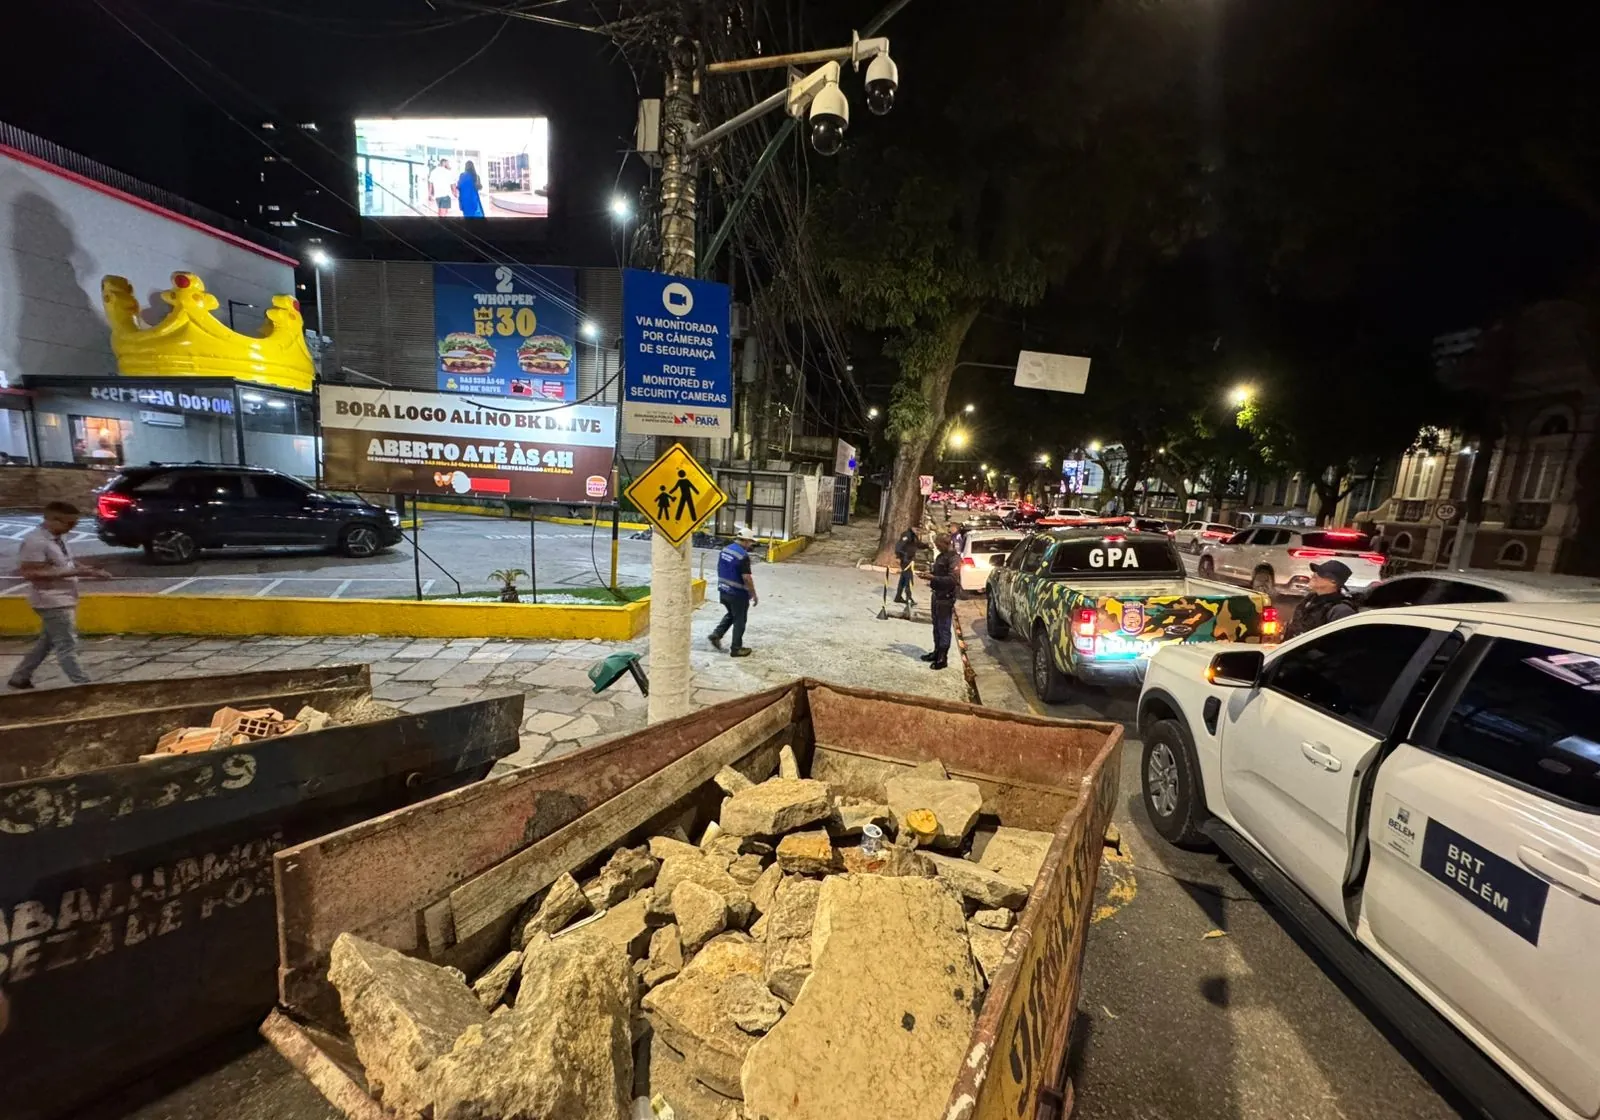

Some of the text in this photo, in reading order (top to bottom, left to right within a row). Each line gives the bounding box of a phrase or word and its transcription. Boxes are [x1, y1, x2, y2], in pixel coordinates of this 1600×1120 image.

[495, 266, 514, 293] 2
[473, 293, 534, 306] WHOPPER
[474, 307, 537, 337] R$ 30
[635, 315, 719, 335] VIA MONITORADA
[642, 330, 713, 347] POR CÂMERAS
[640, 343, 716, 361] DE SEGURANÇA
[663, 364, 697, 377] ROUTE
[642, 374, 715, 390] MONITORED BY
[631, 386, 727, 403] SECURITY CAMERAS
[335, 400, 391, 418] BORA
[394, 405, 447, 422] LOGO
[485, 411, 511, 427] NO
[514, 413, 541, 429] BK
[367, 438, 574, 469] ABERTO ATÉ ÀS 4H
[1089, 547, 1139, 568] GPA
[1447, 843, 1486, 874] BRT
[1444, 861, 1509, 912] BELÉM
